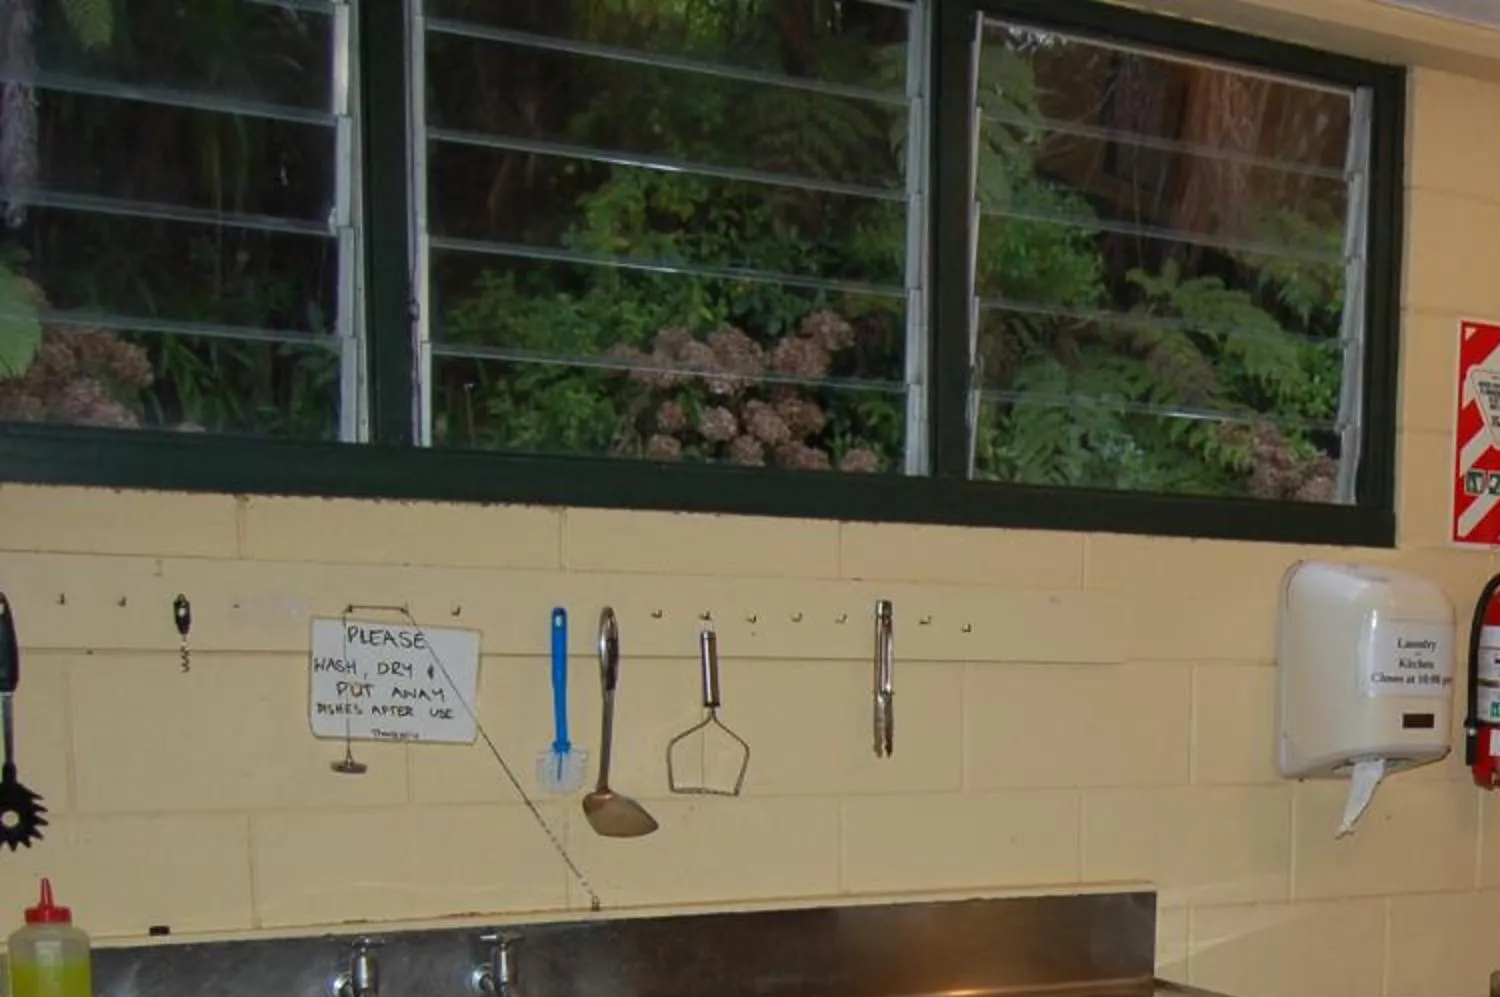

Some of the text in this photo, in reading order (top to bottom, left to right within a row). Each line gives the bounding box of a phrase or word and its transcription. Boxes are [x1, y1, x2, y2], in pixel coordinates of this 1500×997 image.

[347, 626, 426, 649] PLEASE
[378, 661, 412, 679] DRY
[336, 681, 445, 703] PUT AWAY
[317, 701, 454, 720] DISHES AFTER USE
